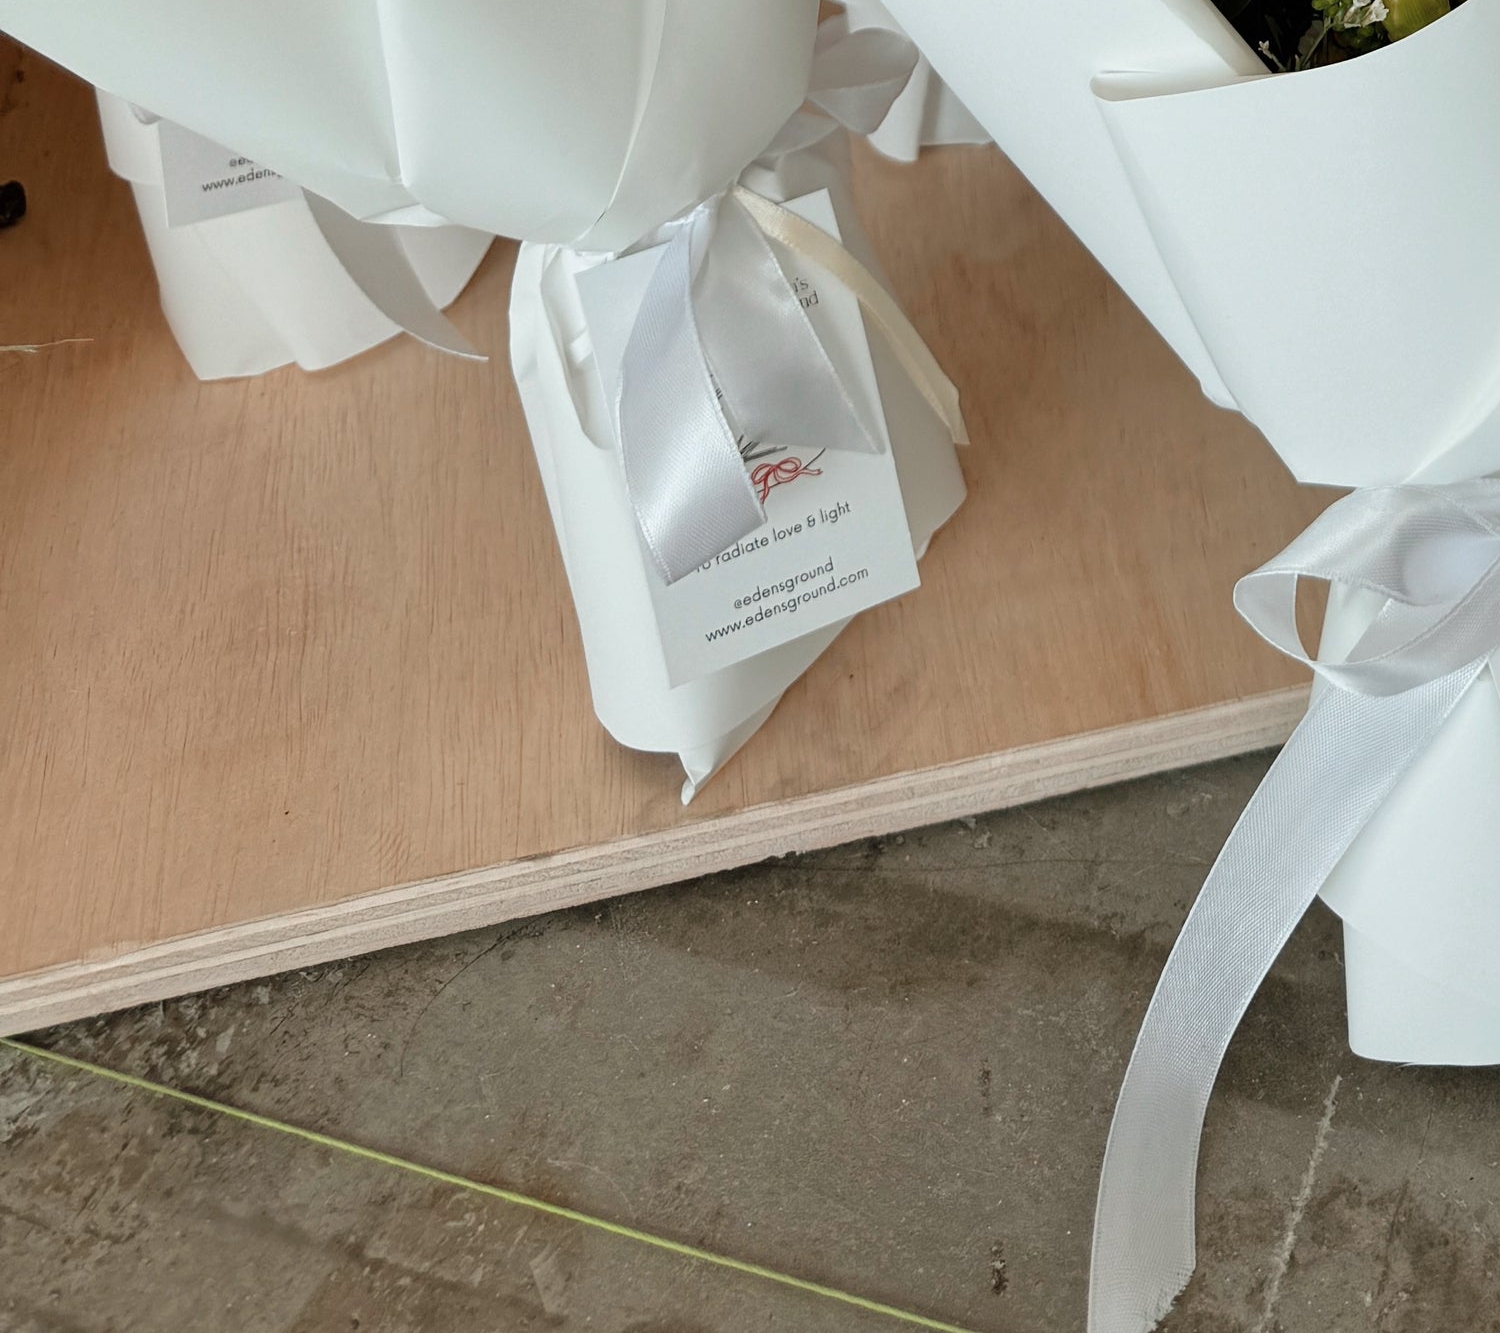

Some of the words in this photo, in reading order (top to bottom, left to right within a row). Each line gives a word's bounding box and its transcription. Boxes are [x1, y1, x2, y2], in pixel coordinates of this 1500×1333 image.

[716, 537, 769, 565] radiate
[773, 523, 803, 542] love
[807, 515, 816, 527] &
[820, 501, 851, 523] light
[705, 567, 869, 642] www.edensground.com
[734, 556, 834, 609] @edensground
